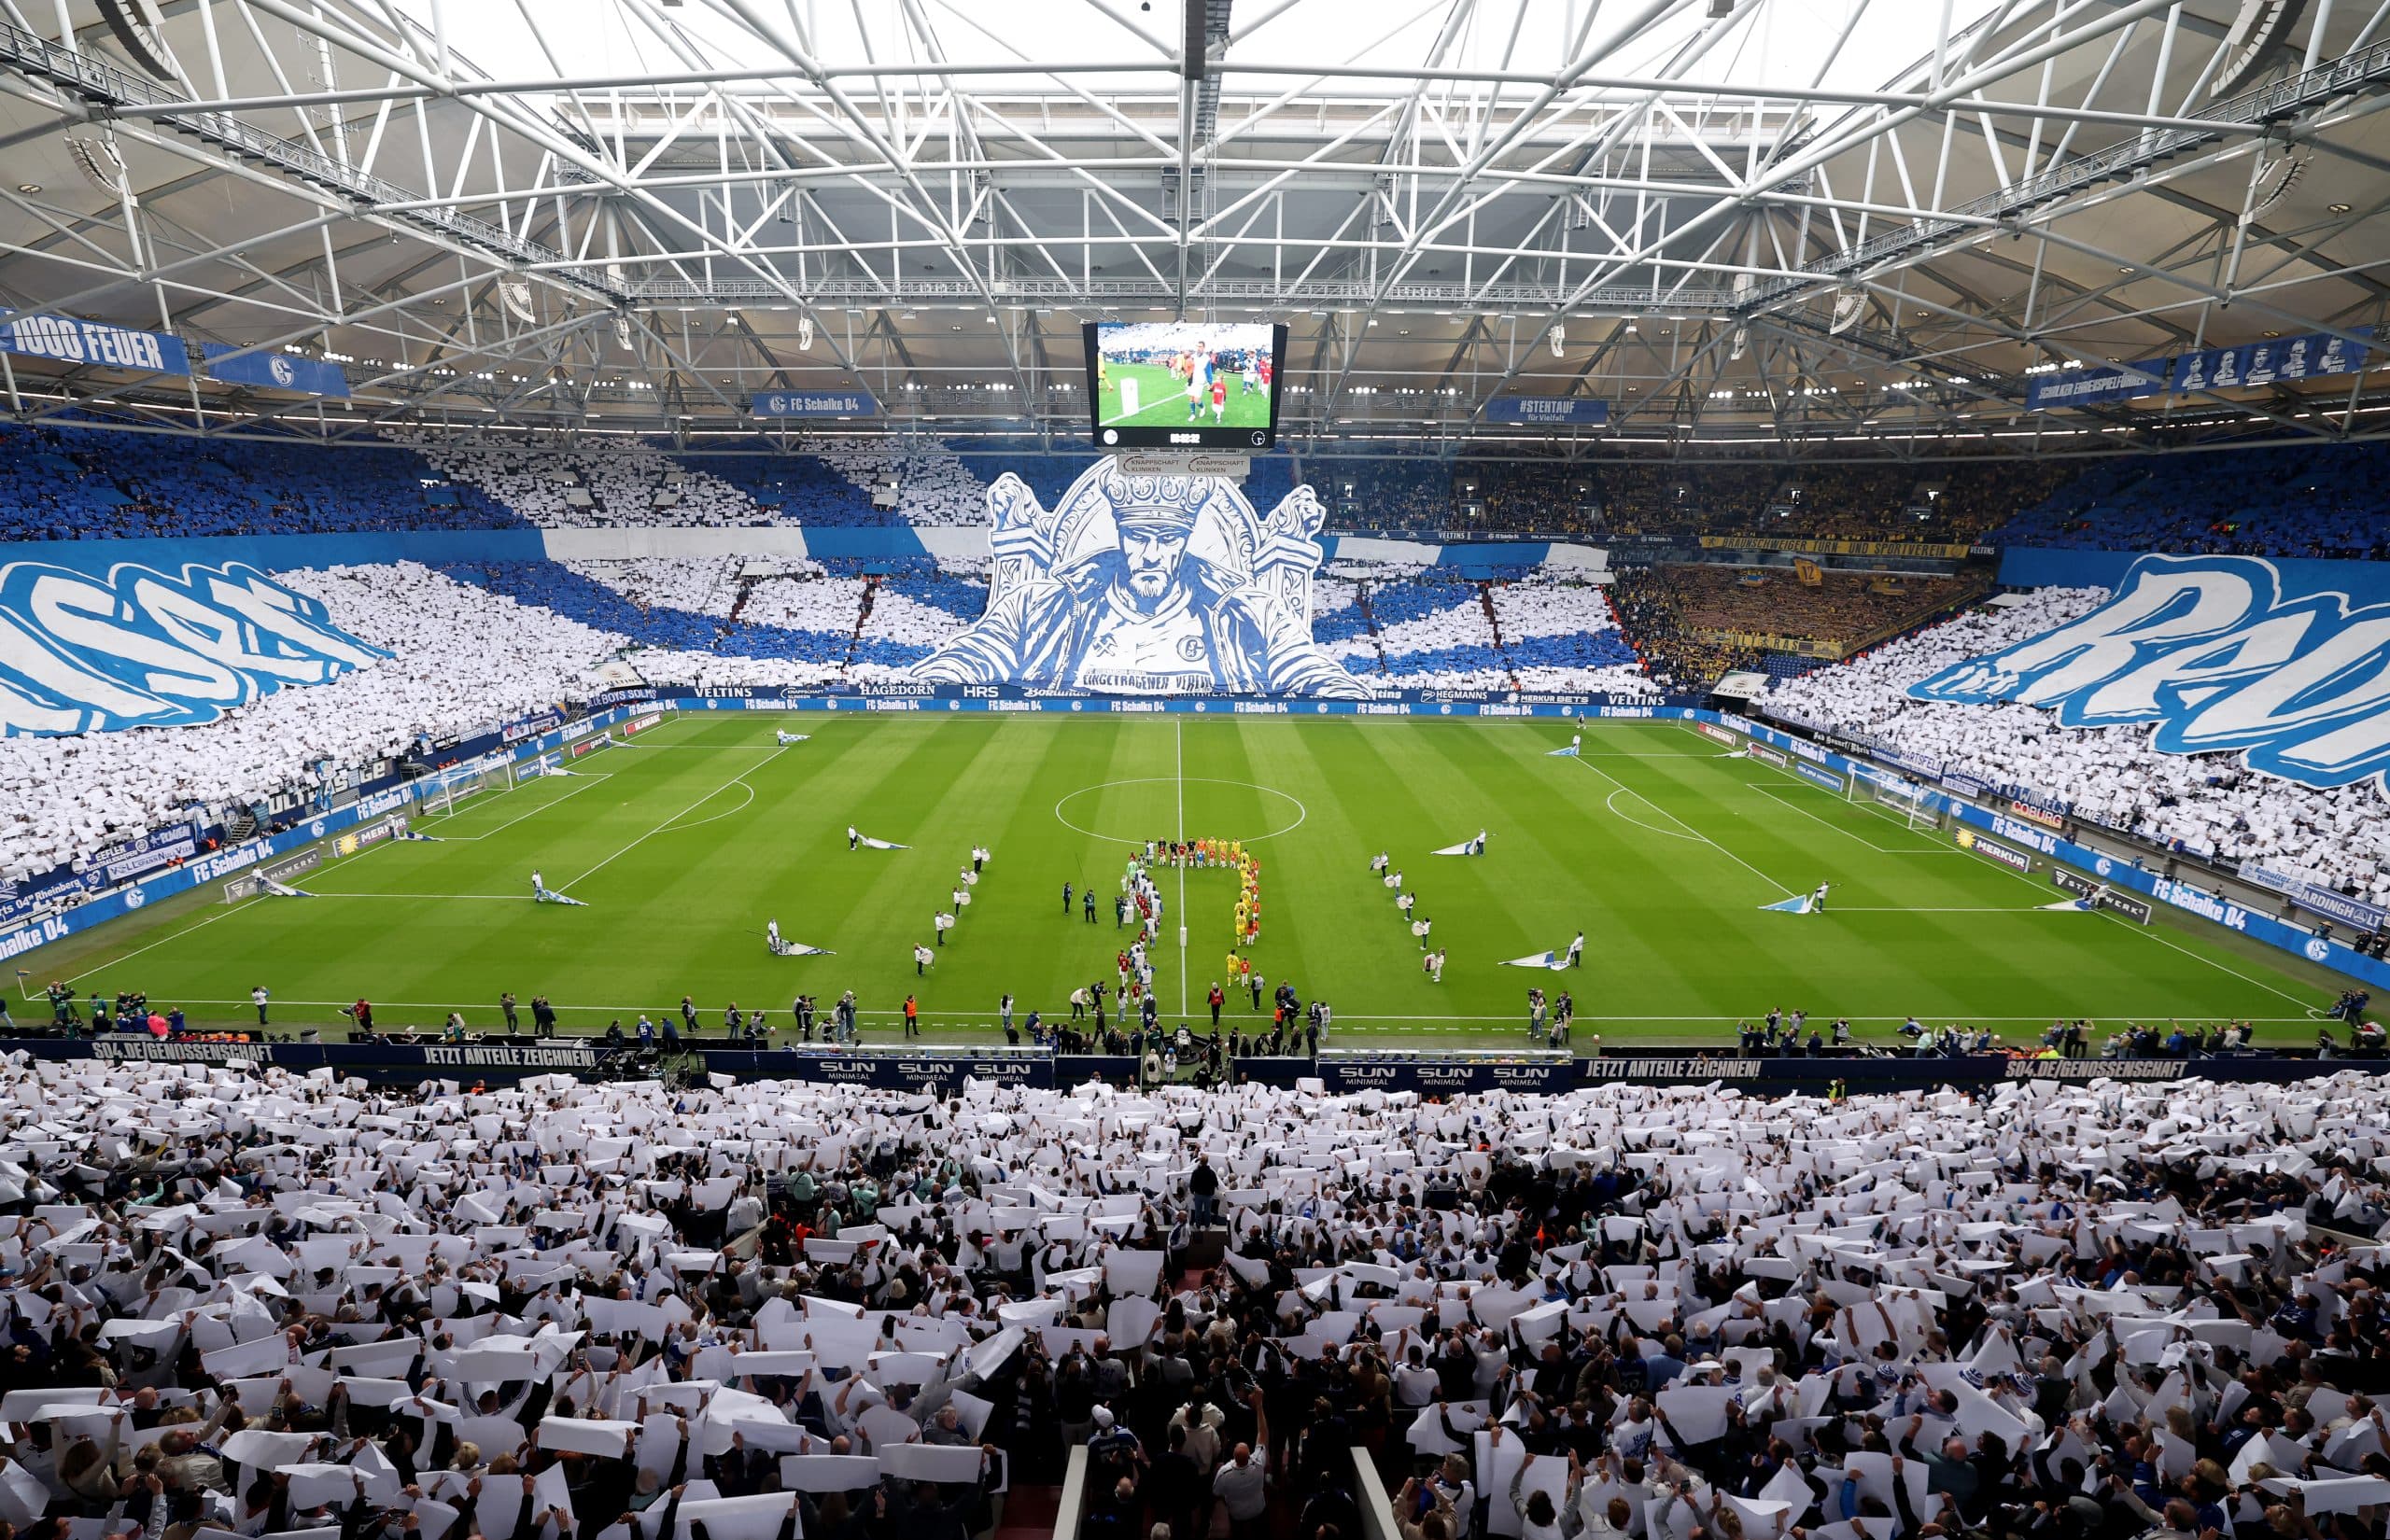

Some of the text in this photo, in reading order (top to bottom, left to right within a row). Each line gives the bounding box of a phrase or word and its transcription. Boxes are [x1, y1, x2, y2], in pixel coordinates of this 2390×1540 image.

[11, 316, 165, 371] 1000 FEUER
[791, 398, 859, 411] FC Schalke 04
[1519, 399, 1576, 413] #STEHTAUF
[1527, 413, 1565, 422] für Vielfalt
[1438, 530, 1465, 539] VELTINS
[1722, 537, 1947, 557] BRAUNSCHWEIGER TURN UND SPORTVEREIN
[1802, 566, 1815, 581] 12
[1083, 673, 1213, 692] EINGETRAGENER VEREIN
[602, 690, 626, 705] BOYS
[627, 688, 657, 700] SOLMS
[695, 687, 752, 698] VELTINS
[861, 685, 935, 696] HAGEDORN
[963, 685, 999, 698] HRS
[1436, 691, 1488, 700] HEGMANNS
[745, 698, 798, 710] FC Schalke 04
[866, 699, 921, 710] FC Schalke 04
[1520, 694, 1589, 704] MERKUR BETS
[1608, 694, 1666, 706] VELTINS
[989, 700, 1043, 711] FC Schalke 04
[1111, 701, 1165, 712] FC Schalke 04
[1234, 702, 1288, 713] FC Schalke 04
[1357, 703, 1411, 715] FC Schalke 04
[1479, 705, 1533, 716] FC Schalke 04
[1600, 706, 1653, 718] FC Schalke 04
[2019, 786, 2068, 816] WINKELS
[2012, 800, 2062, 825] COBURG
[1990, 816, 2056, 855] FC Schalke 04
[1975, 838, 2027, 869] MERKUR
[192, 839, 274, 884] FC Schalke 04
[35, 878, 82, 903] Rheinberg
[2151, 878, 2248, 931] FC Schalke 04
[43, 915, 69, 942] 04
[91, 1042, 275, 1062] S04.DE/GENOSSENSCHAFT
[425, 1046, 596, 1067] JETZT ANTEILE ZEICHNEN!
[820, 1061, 876, 1072] SUN
[898, 1063, 954, 1074] SUN
[974, 1064, 1031, 1074] SUN
[1339, 1067, 1397, 1078] SUN
[1586, 1060, 1762, 1078] JETZT ANTEILE ZEICHNEN!
[2004, 1059, 2188, 1079] S04.DE/GENOSSENSCHAFT
[1416, 1068, 1473, 1078] SUN
[1494, 1068, 1550, 1079] SUN
[1423, 1078, 1467, 1086] MINIMEAL
